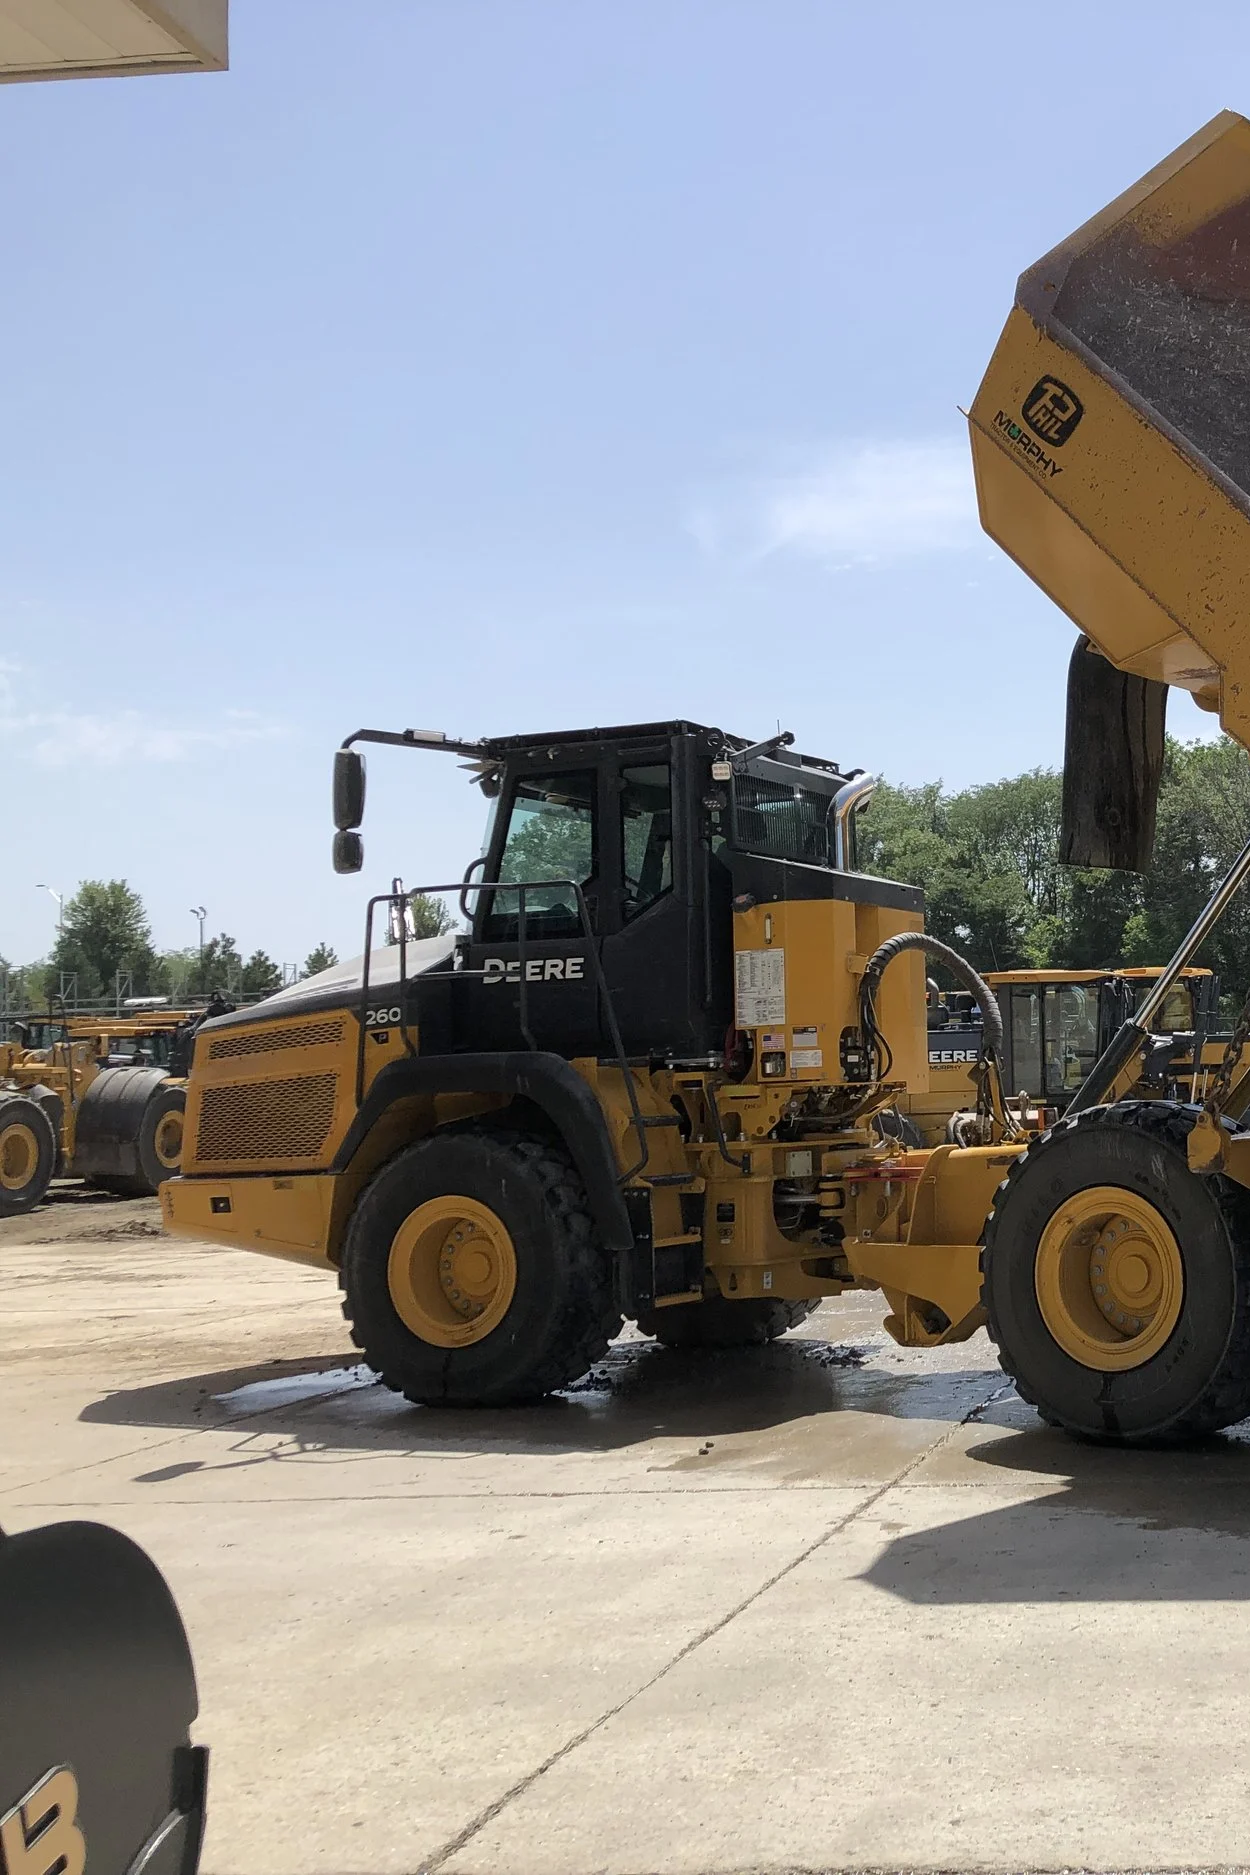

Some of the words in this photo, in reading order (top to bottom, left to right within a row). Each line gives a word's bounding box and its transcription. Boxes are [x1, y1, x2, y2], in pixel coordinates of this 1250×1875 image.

[989, 422, 1011, 444] TRACTOR
[1012, 445, 1040, 471] EQUIPMENT
[993, 410, 1064, 478] MURPHY
[365, 1007, 402, 1025] 260
[929, 1050, 978, 1063] EERE
